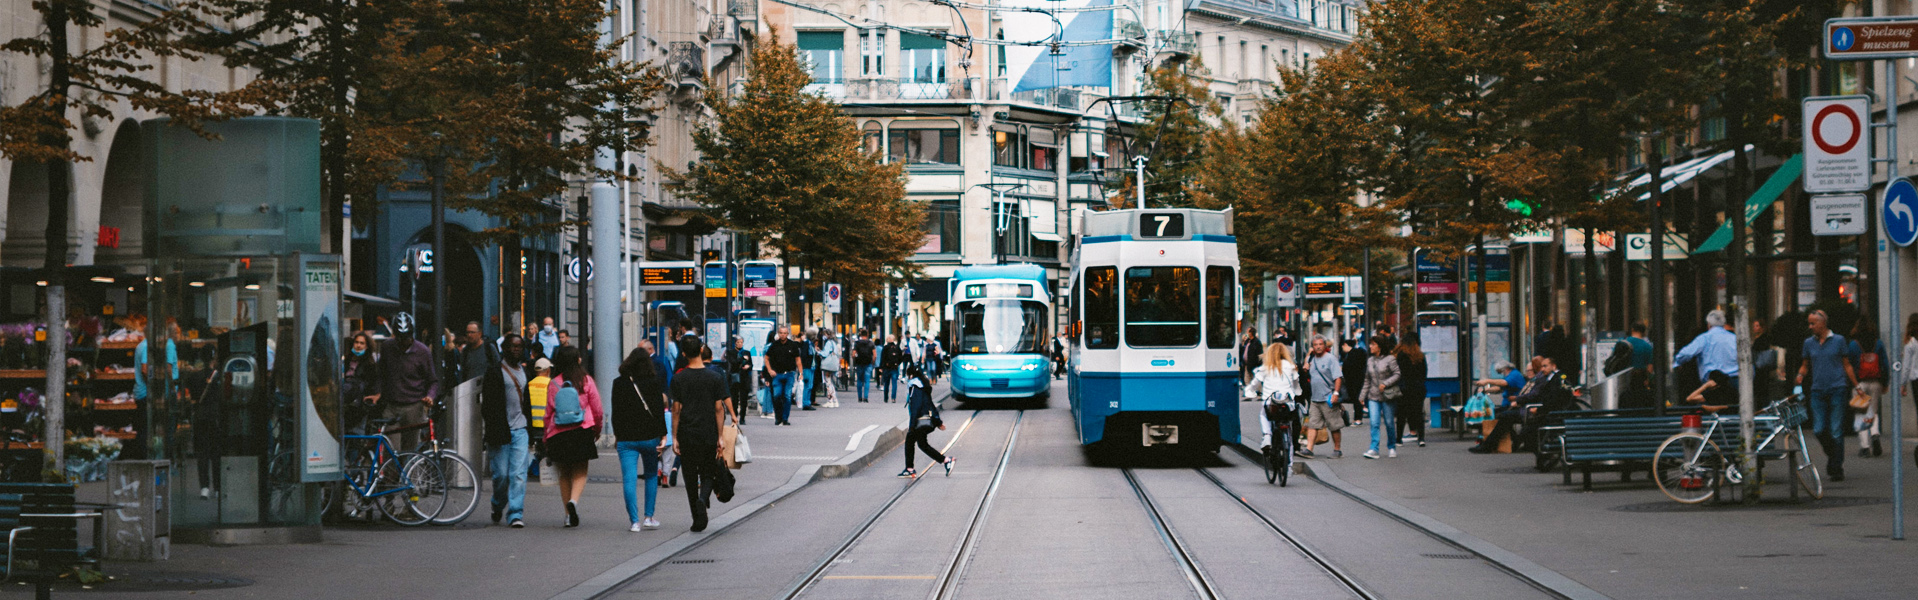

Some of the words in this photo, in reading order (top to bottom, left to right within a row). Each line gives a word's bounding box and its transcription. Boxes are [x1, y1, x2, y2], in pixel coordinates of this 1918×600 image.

[1861, 26, 1915, 39] Spielzeug-
[1863, 41, 1910, 49] museum
[1815, 203, 1861, 211] ausgenommen
[1154, 215, 1170, 237] 7
[970, 286, 980, 296] 11
